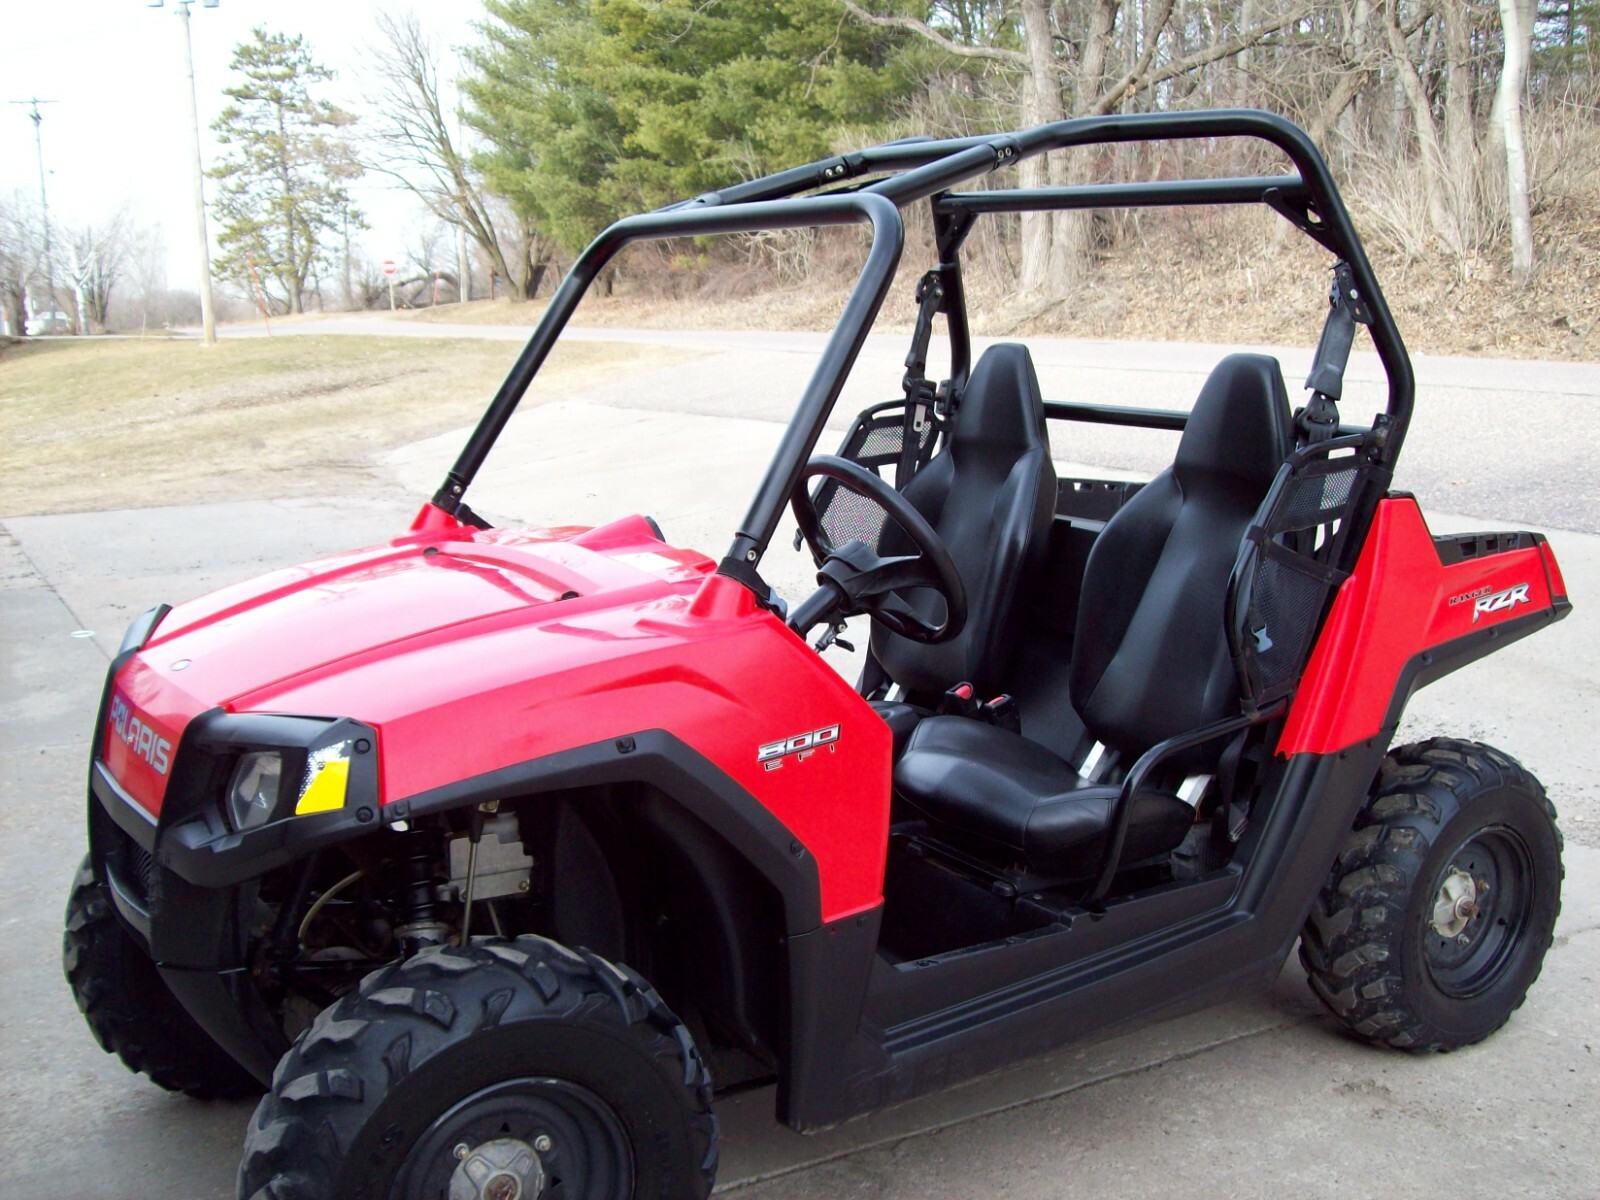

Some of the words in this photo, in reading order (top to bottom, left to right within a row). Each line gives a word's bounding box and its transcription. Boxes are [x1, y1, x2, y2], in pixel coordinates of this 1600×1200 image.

[1449, 585, 1492, 607] RANGER
[1472, 582, 1531, 624] RZR
[110, 694, 171, 775] POLARIS
[758, 723, 841, 762] 800
[764, 743, 835, 772] EFI
